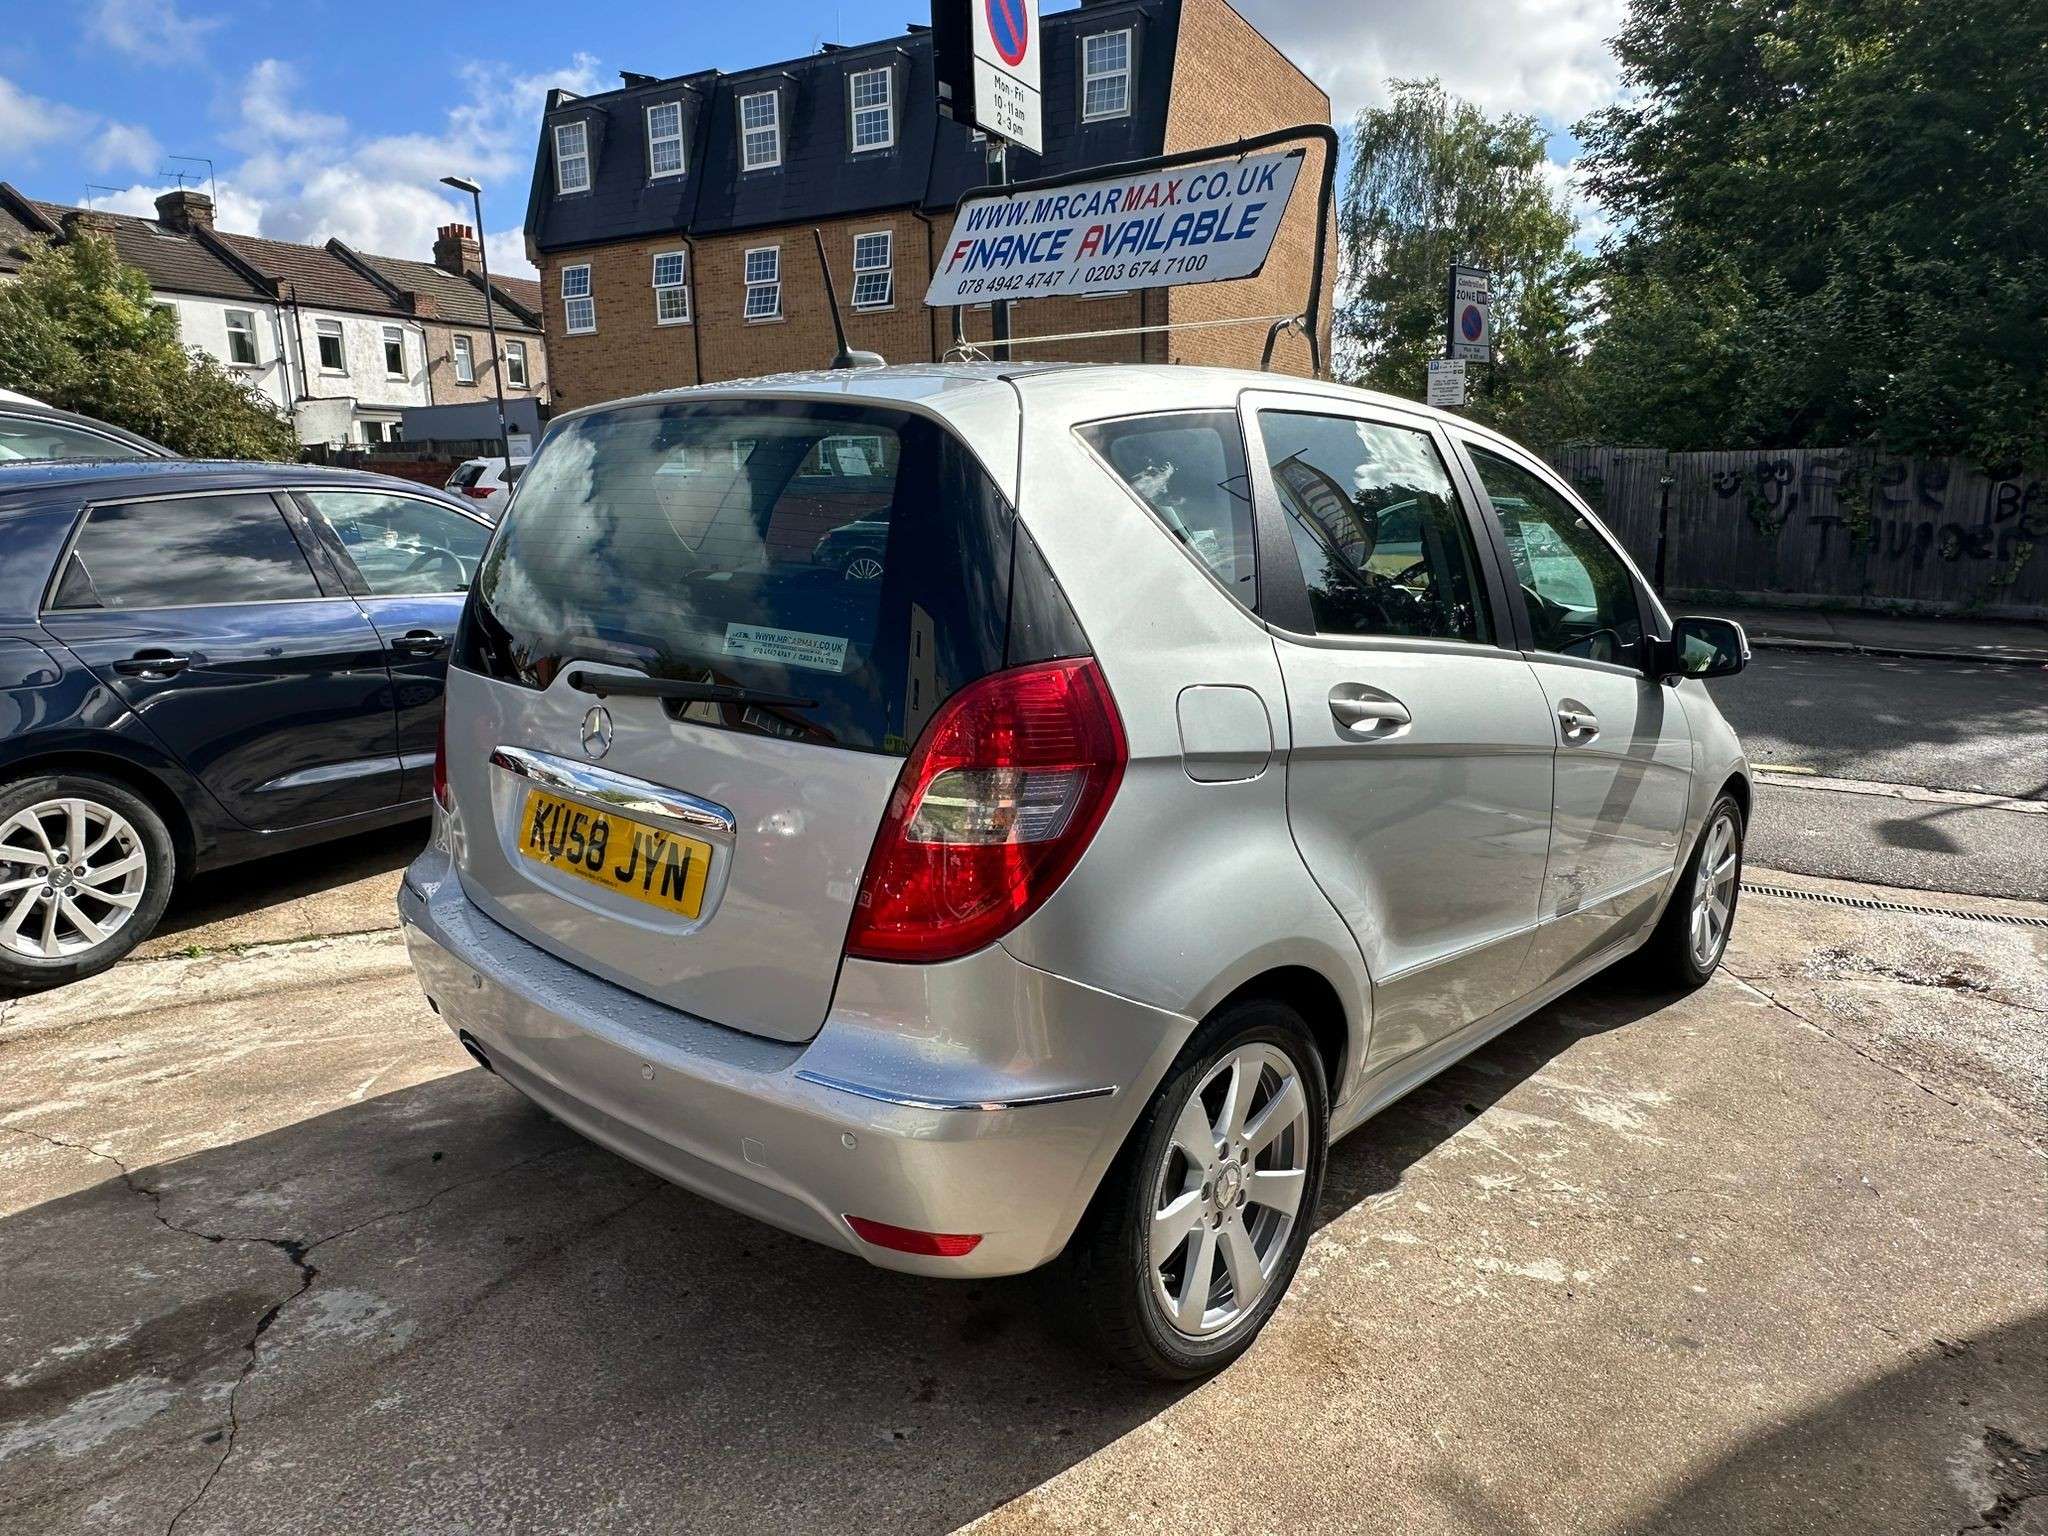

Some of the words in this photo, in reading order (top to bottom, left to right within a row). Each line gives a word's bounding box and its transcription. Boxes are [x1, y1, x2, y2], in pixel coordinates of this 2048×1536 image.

[994, 75, 1009, 96] Mon
[1014, 86, 1024, 102] Fri
[994, 94, 1003, 109] 10
[996, 112, 1002, 125] 2
[1006, 117, 1012, 131] 3
[966, 162, 1282, 232] WWW.MRCARMAX.CO.UK
[945, 228, 1073, 275] FINANCE
[1073, 202, 1268, 263] AVAILABLE
[957, 278, 985, 296] 078
[986, 274, 1024, 293] 4942
[1024, 271, 1065, 289] 4747
[1068, 268, 1080, 285] /
[1084, 264, 1125, 283] 0203
[1128, 259, 1161, 279] 674
[1164, 254, 1208, 275] 7100
[1456, 290, 1475, 302] ZONE
[529, 799, 609, 873] KU58
[614, 831, 693, 902] JYN
